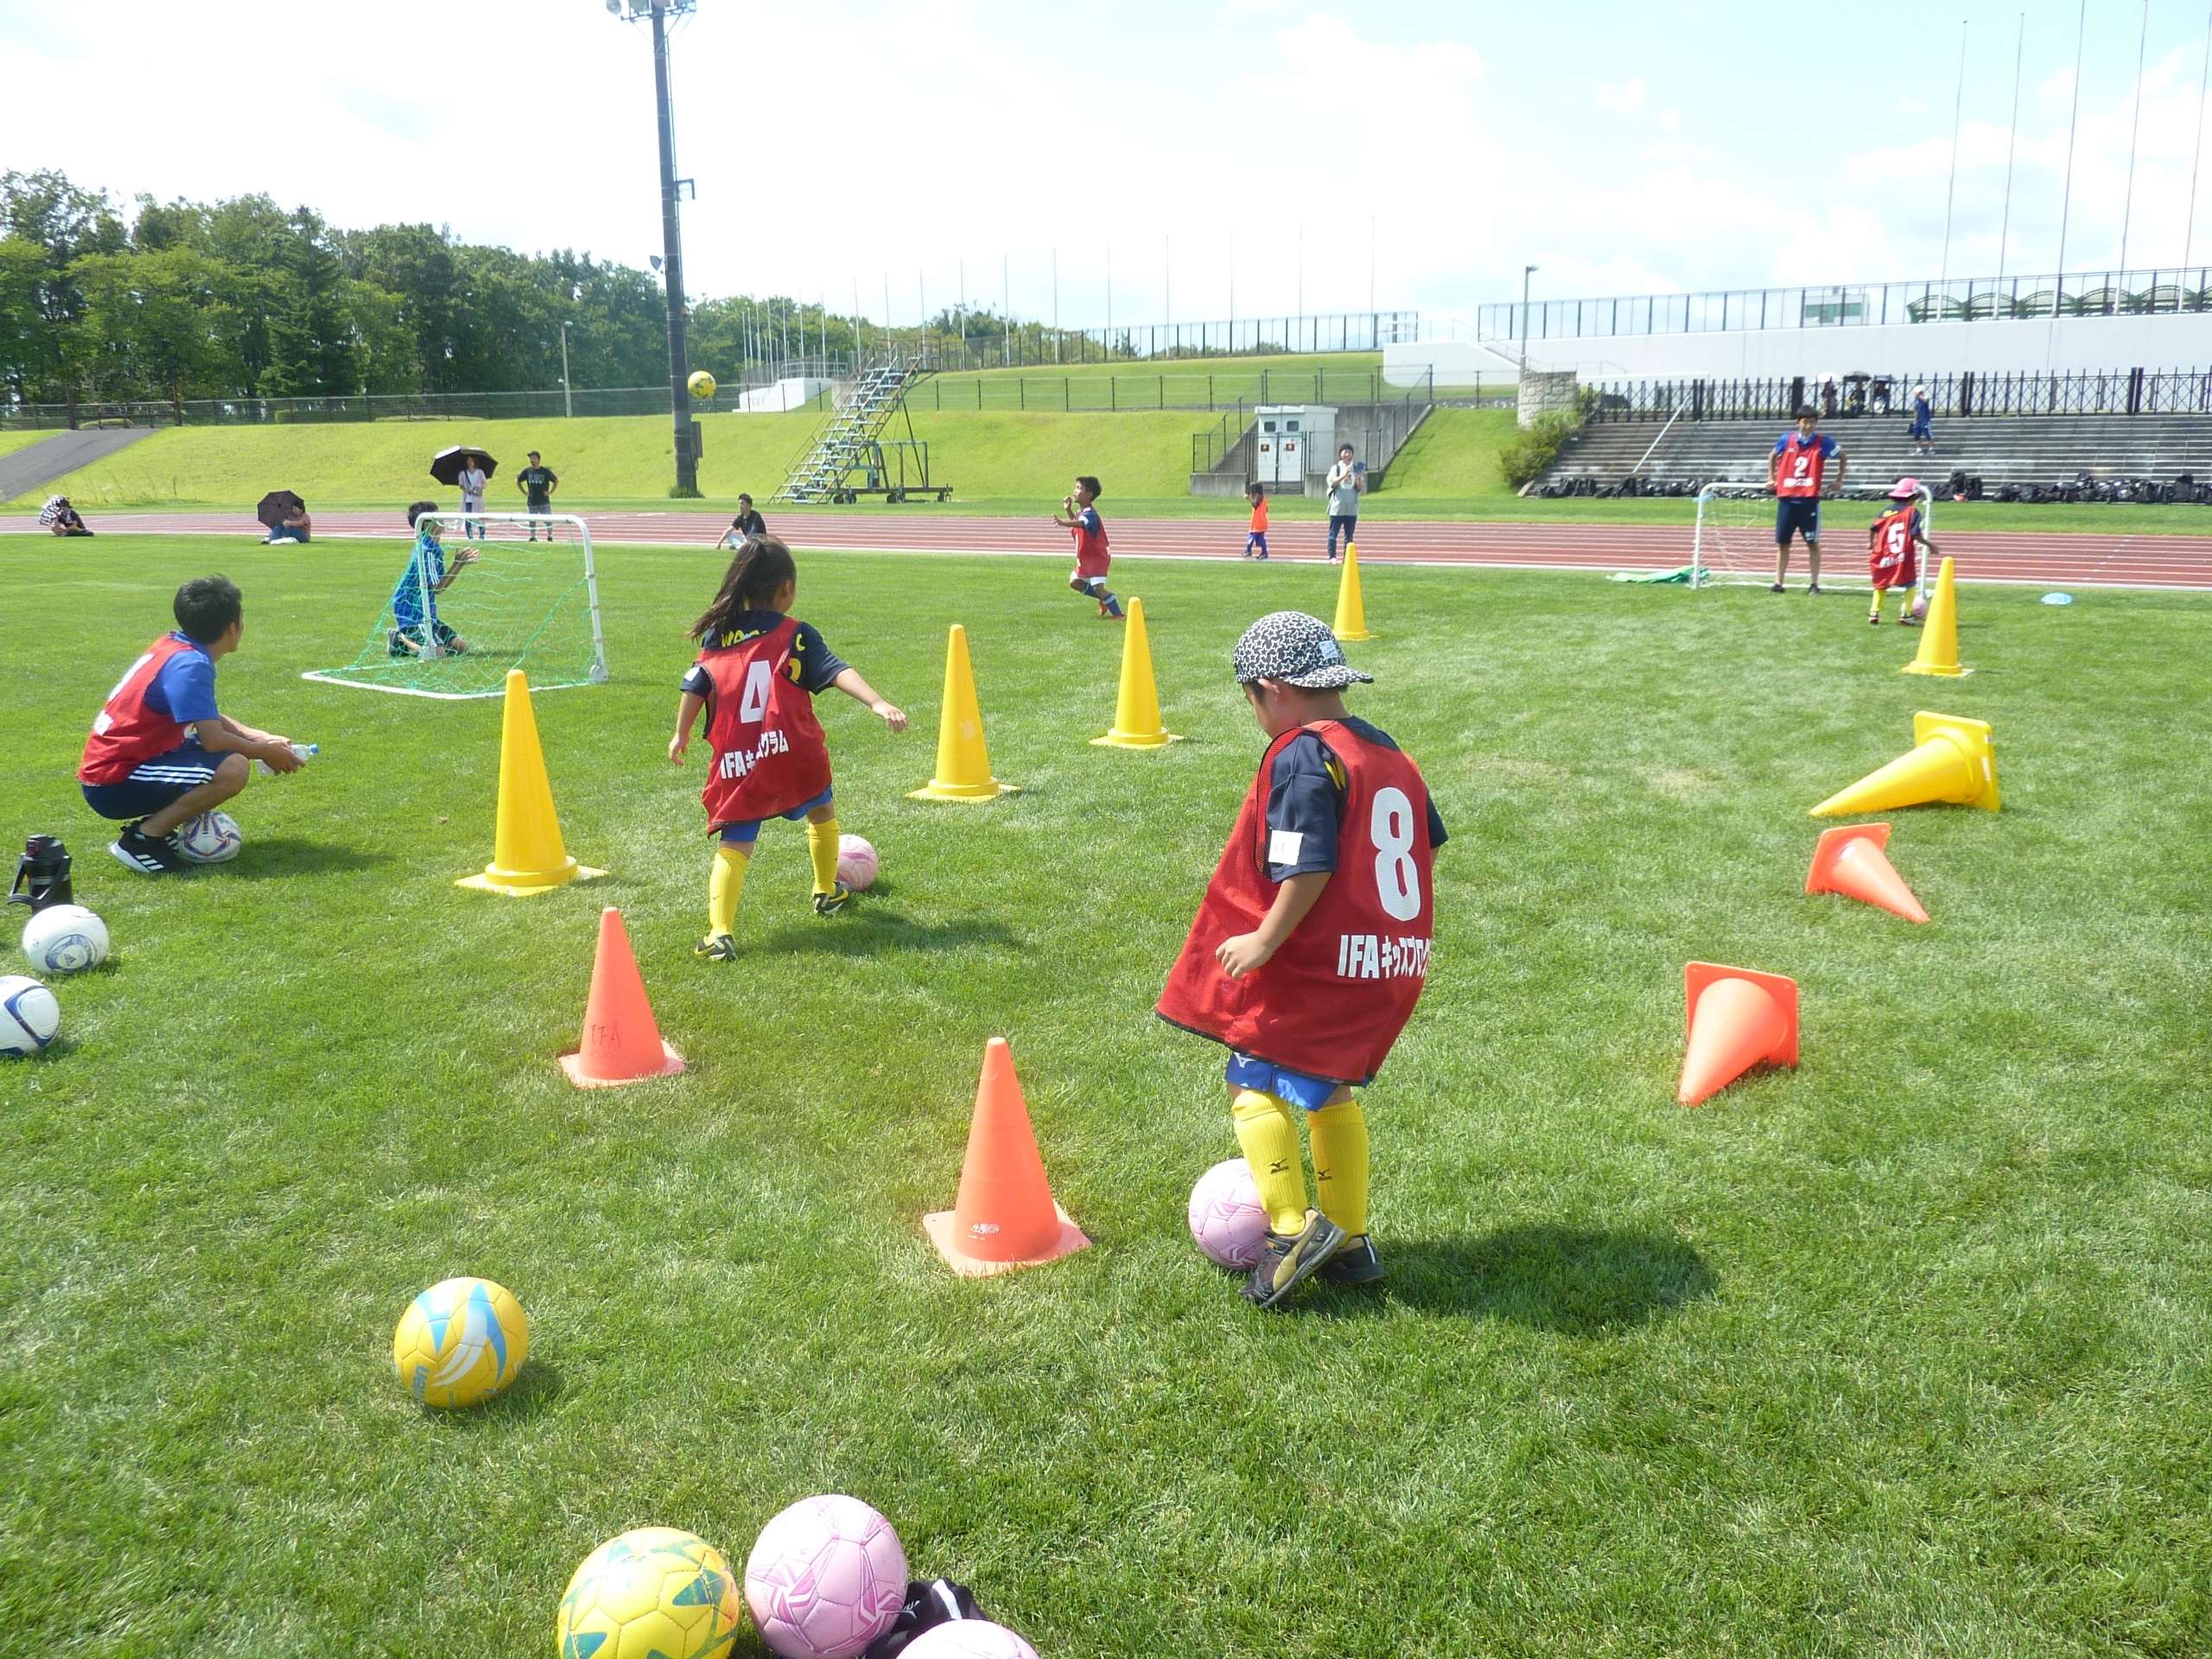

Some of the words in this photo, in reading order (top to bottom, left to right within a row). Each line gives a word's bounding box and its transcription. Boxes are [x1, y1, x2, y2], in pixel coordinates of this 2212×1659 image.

[1794, 455, 1808, 478] 2
[1887, 521, 1906, 554] 5
[740, 659, 772, 724] 4
[1370, 786, 1421, 922] 8
[590, 1021, 621, 1048] IFA
